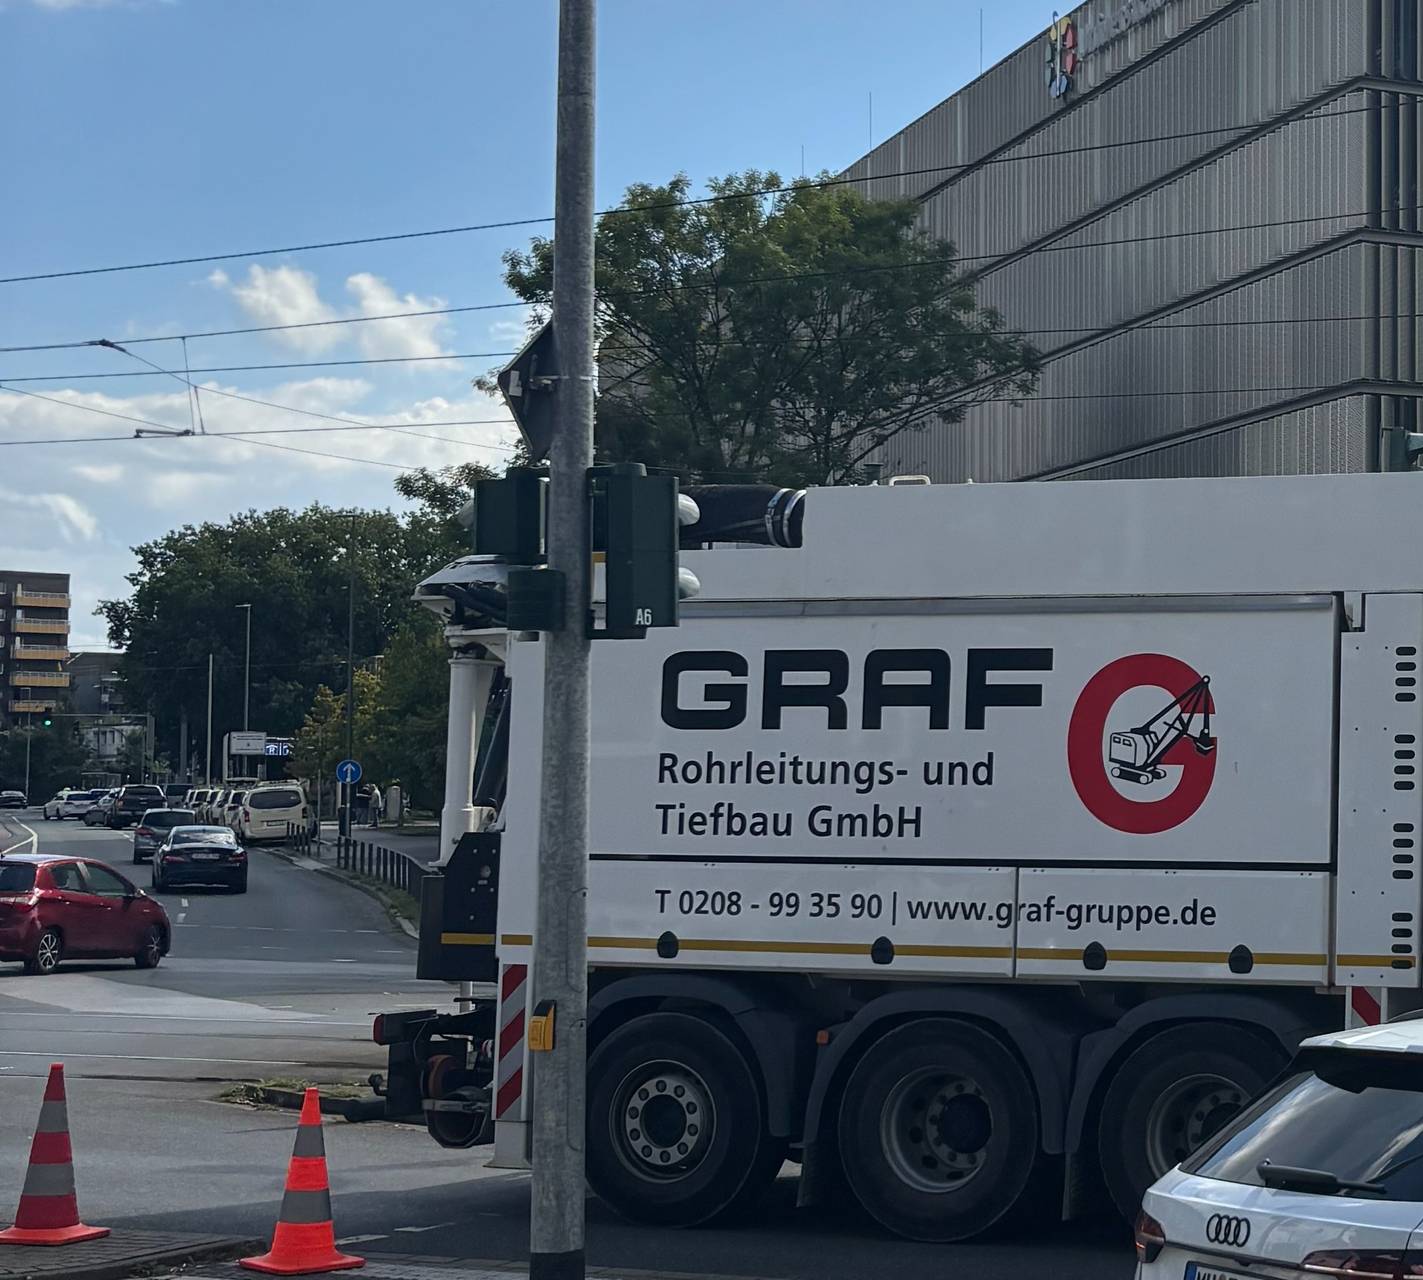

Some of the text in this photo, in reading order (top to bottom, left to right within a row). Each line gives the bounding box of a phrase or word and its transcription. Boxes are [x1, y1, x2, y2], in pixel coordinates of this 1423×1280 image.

[635, 608, 652, 626] A6
[660, 648, 1054, 731] GRAF
[658, 750, 994, 795] Rohrleitungs- und
[655, 801, 922, 838] Tiefbau GmbH
[654, 889, 672, 914] T
[678, 890, 742, 916] 0208
[768, 892, 800, 918] 99
[809, 893, 841, 918] 35
[850, 893, 883, 919] 90
[906, 895, 1217, 934] www.graf-gruppe.de
